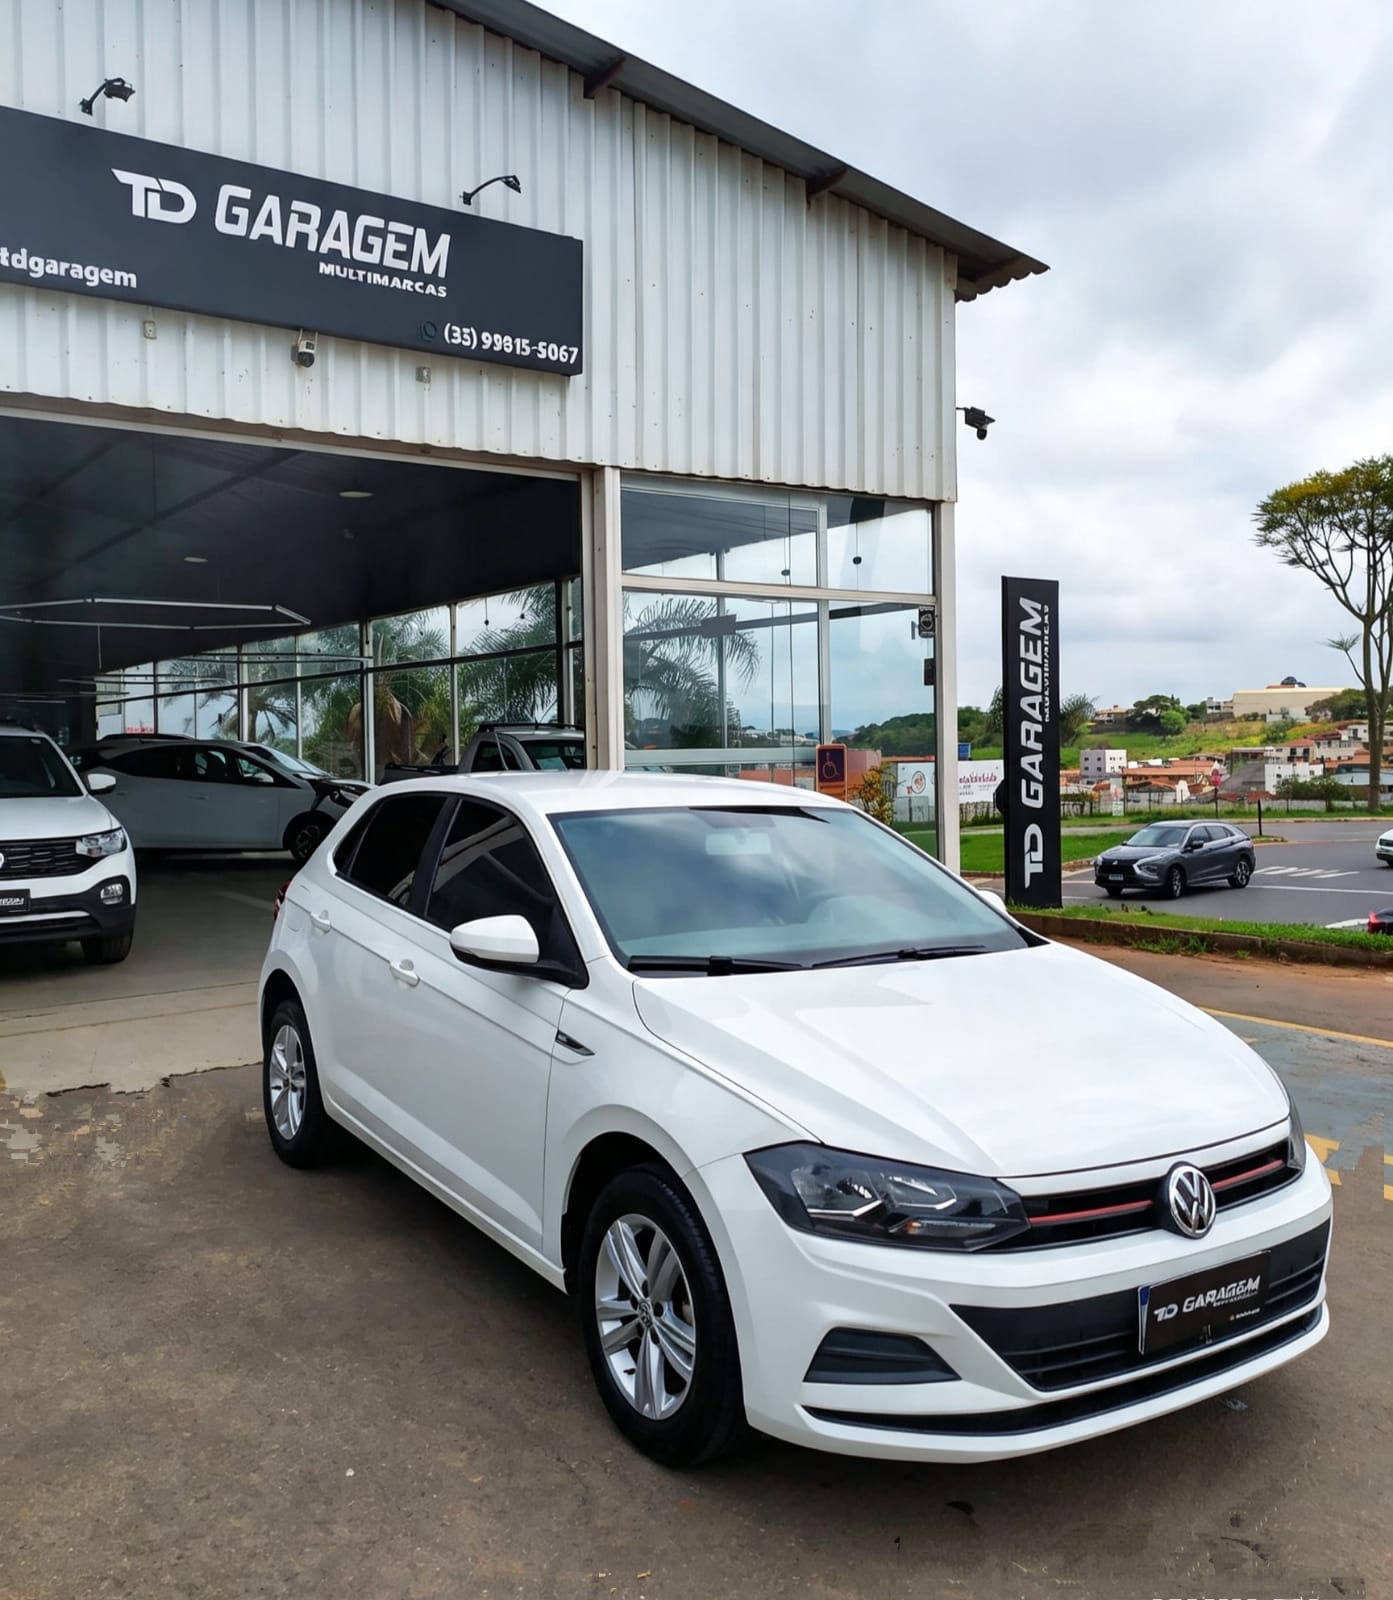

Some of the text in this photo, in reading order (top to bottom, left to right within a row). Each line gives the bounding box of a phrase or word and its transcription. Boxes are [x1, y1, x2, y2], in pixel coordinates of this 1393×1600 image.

[111, 168, 451, 278] TD GARAGEM
[0, 247, 137, 288] tdgaragem
[319, 262, 448, 298] MULTIMARCAS
[481, 331, 579, 364] 99815-5067
[1019, 597, 1043, 888] TD GARAGEM
[1182, 1275, 1261, 1313] GARAGEM
